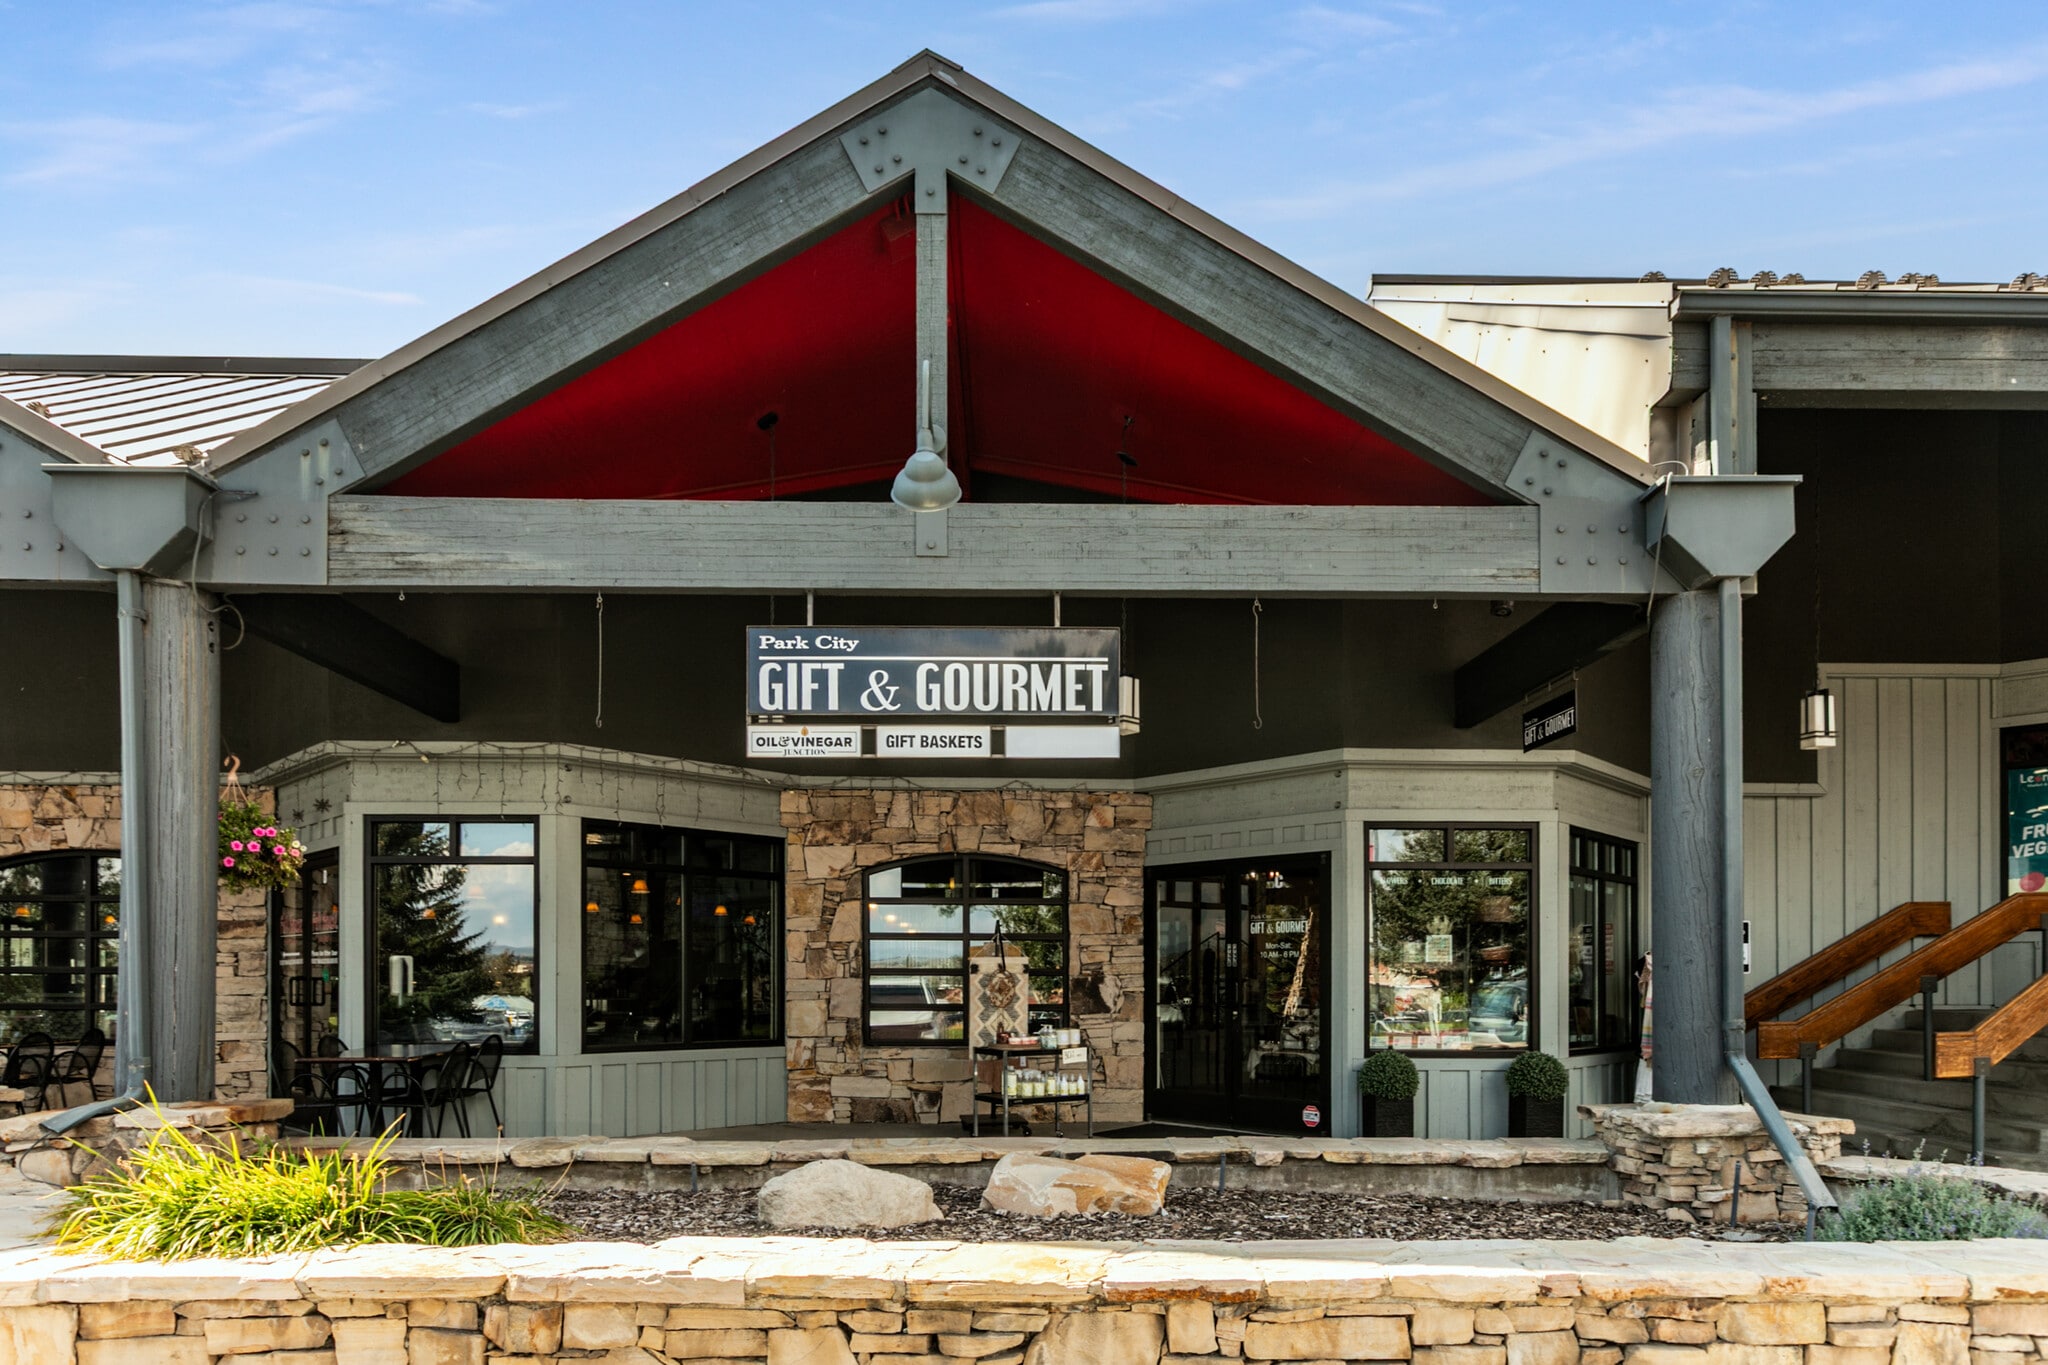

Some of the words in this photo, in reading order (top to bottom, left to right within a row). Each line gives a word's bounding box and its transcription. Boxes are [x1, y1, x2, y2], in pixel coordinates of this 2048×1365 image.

[759, 635, 809, 650] Park
[815, 635, 860, 652] City
[758, 662, 845, 711] GIFT
[860, 669, 901, 712] &
[916, 662, 1109, 712] GOURMET
[1524, 726, 1537, 746] GIFT
[1537, 725, 1544, 740] &
[1545, 709, 1575, 737] GOURMET
[886, 734, 916, 749] GIFT
[920, 734, 983, 749] BASKETS
[783, 748, 826, 756] JUNCTION
[2012, 840, 2048, 859] VEG
[1431, 877, 1464, 886] CHOCOLATE
[1488, 877, 1513, 886] BITTERS
[1250, 921, 1265, 935] GIFT
[1266, 923, 1274, 934] &
[1275, 920, 1309, 934] GOURMET
[1289, 950, 1300, 958] PM
